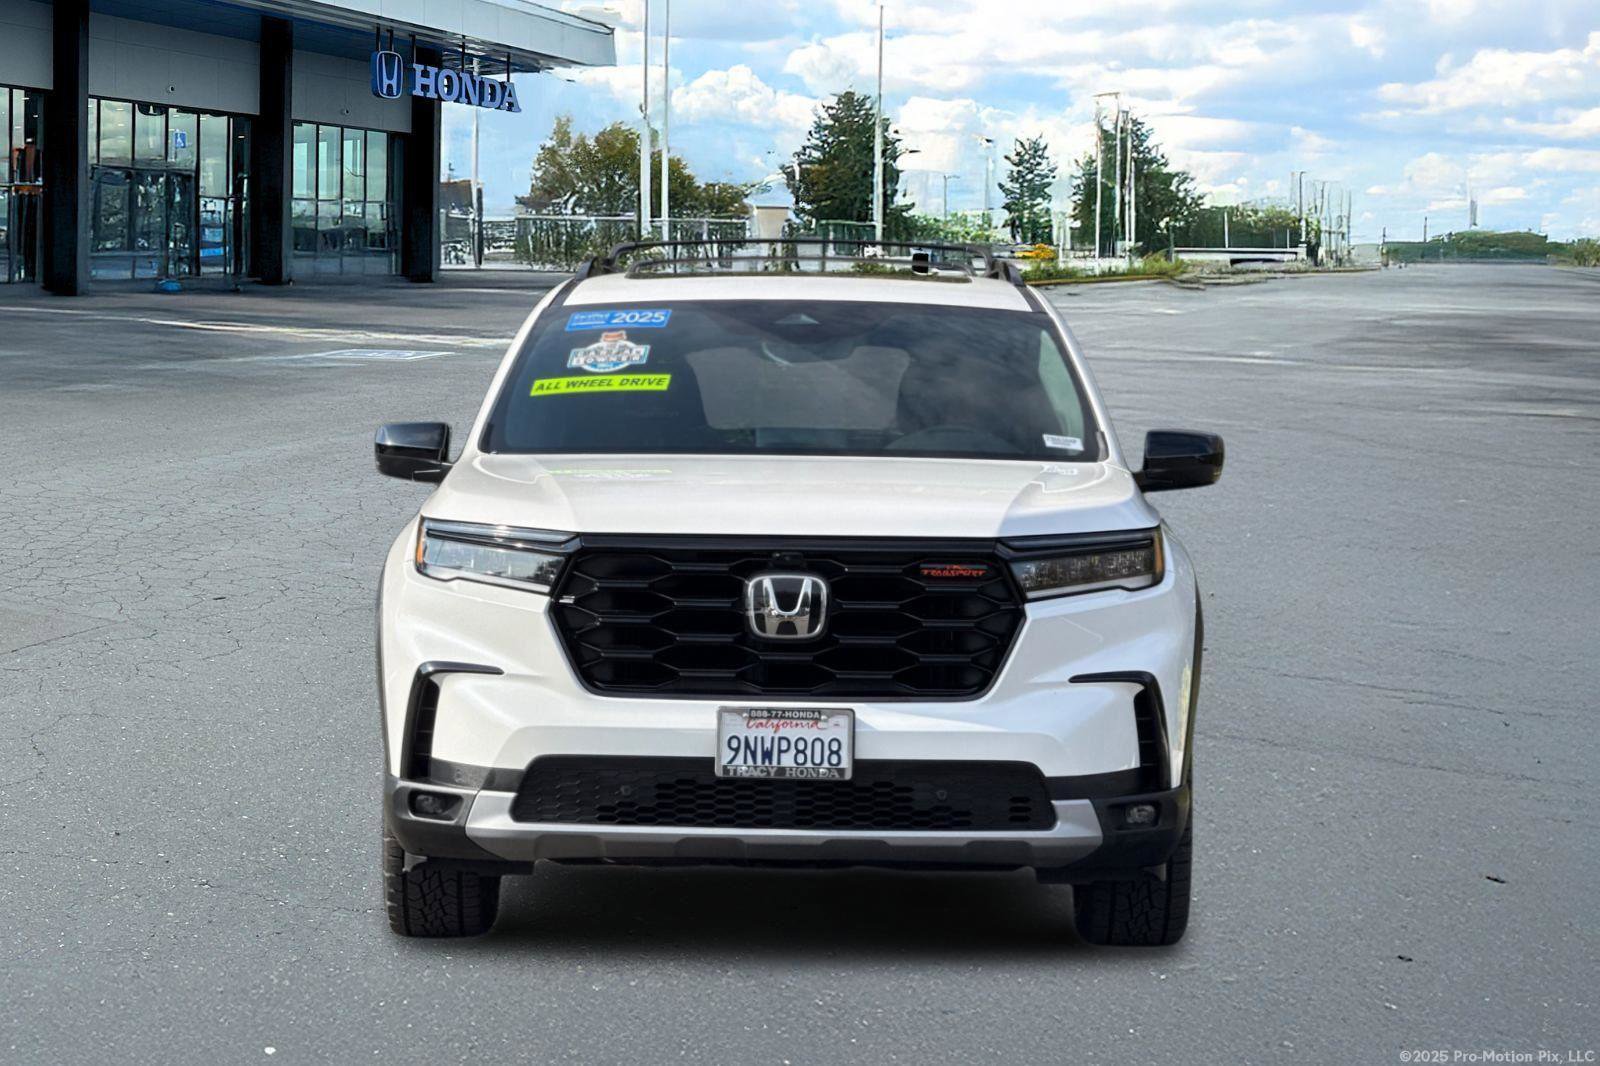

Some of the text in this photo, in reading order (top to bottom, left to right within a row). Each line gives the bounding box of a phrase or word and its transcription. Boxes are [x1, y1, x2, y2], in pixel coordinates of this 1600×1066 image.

[412, 63, 522, 113] HONDA
[611, 310, 668, 324] 2025
[535, 377, 667, 392] ALL WHEEL DRIVE
[750, 710, 820, 719] 888-77-HONDA
[746, 719, 826, 733] California
[726, 735, 842, 767] 9NWP808
[727, 766, 839, 778] TRACY HONDA
